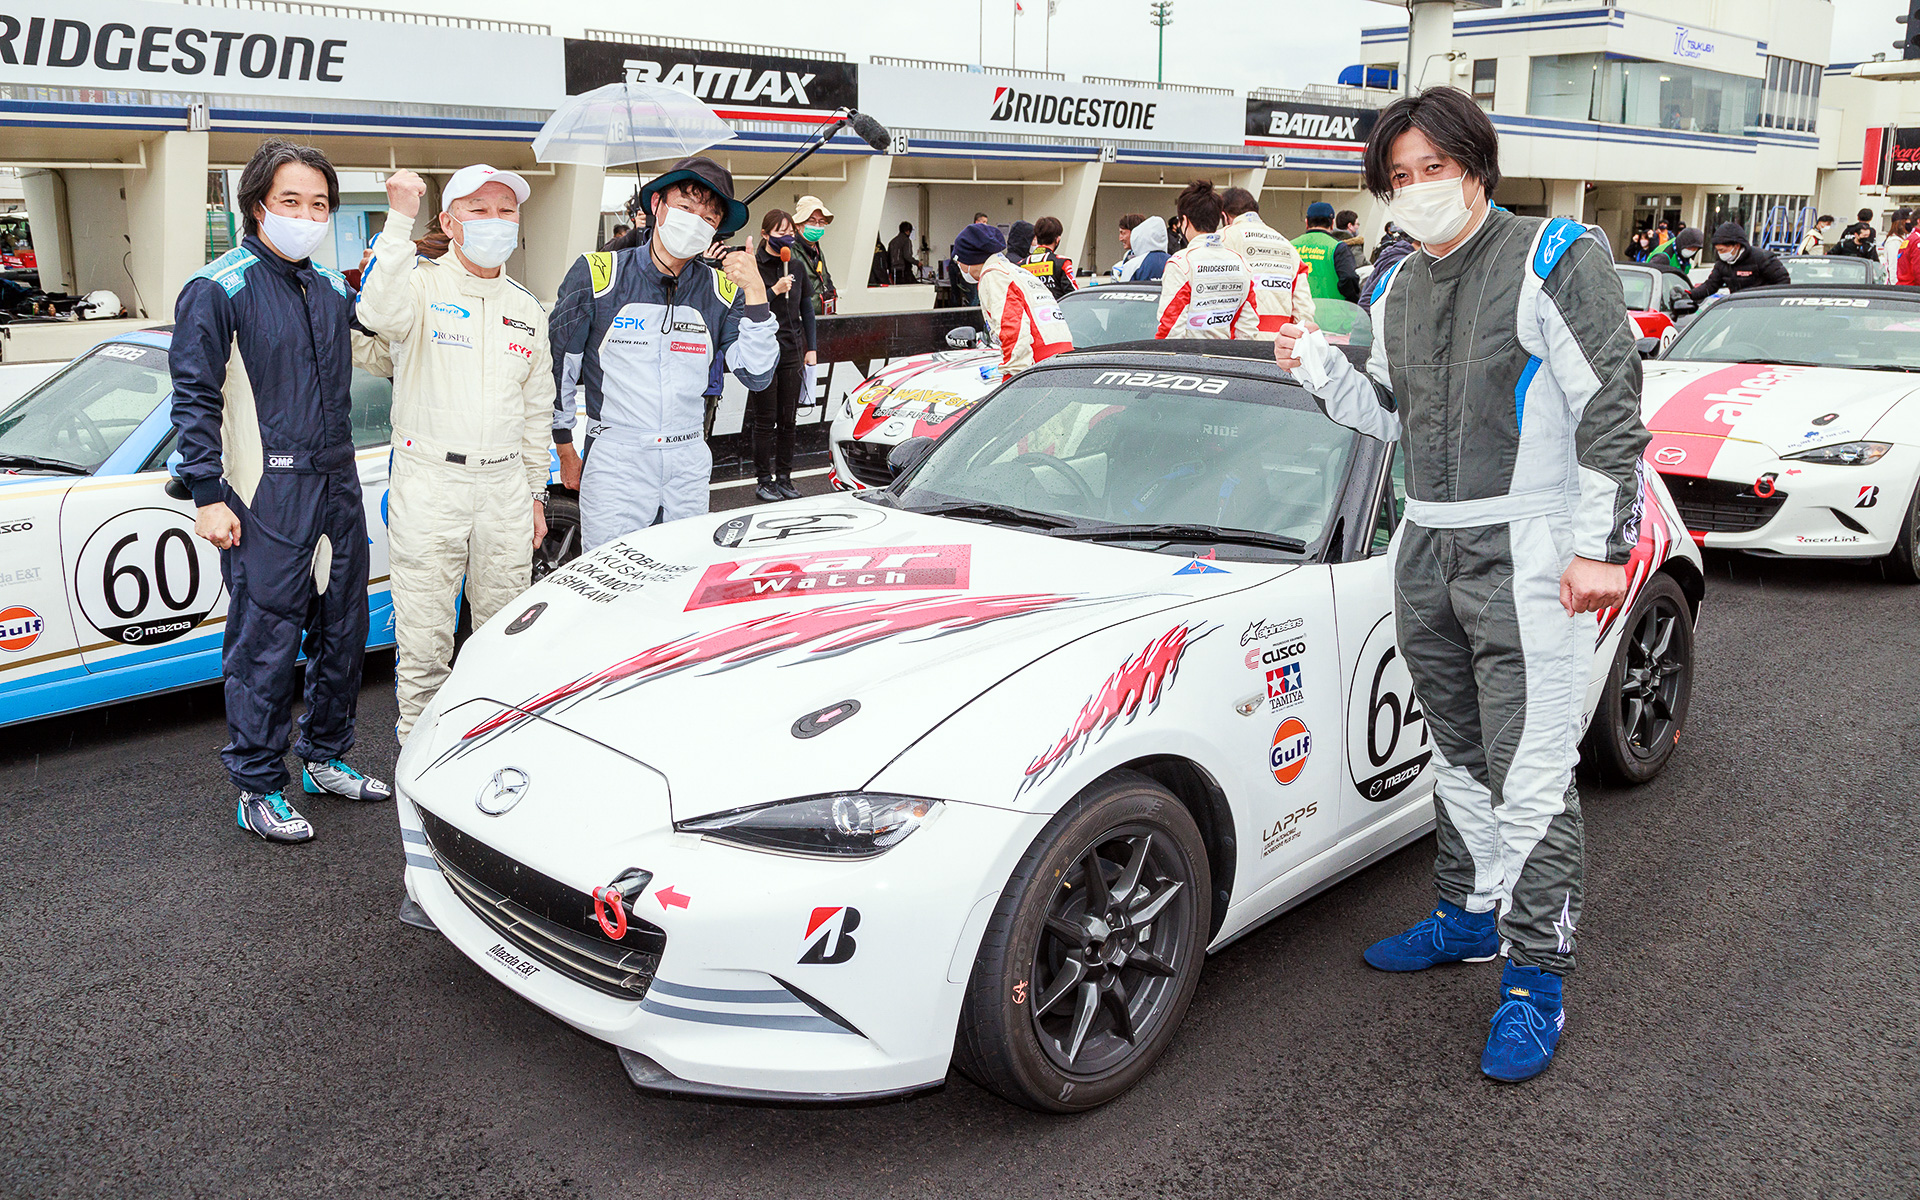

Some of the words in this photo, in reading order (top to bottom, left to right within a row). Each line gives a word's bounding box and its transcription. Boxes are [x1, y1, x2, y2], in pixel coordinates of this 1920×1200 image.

[193, 104, 203, 129] 17
[990, 86, 1157, 130] BRIDGESTONE
[1268, 110, 1359, 140] BATTLAX
[892, 135, 905, 152] 15
[1104, 147, 1114, 161] 14
[1272, 154, 1283, 167] 12
[222, 273, 240, 289] OMP
[1780, 297, 1870, 308] mazda
[613, 317, 645, 330] SPK
[1093, 371, 1230, 394] mazda
[269, 457, 294, 467] OMP
[103, 527, 200, 619] 60
[145, 620, 191, 636] mazda
[1262, 642, 1306, 665] CUSCO
[1269, 690, 1304, 710] TAMIYA
[1271, 735, 1310, 768] Gulf
[1384, 763, 1420, 790] mazda
[1262, 801, 1318, 842] LAPPS
[489, 944, 520, 966] Mazda
[516, 961, 541, 977] E&T
